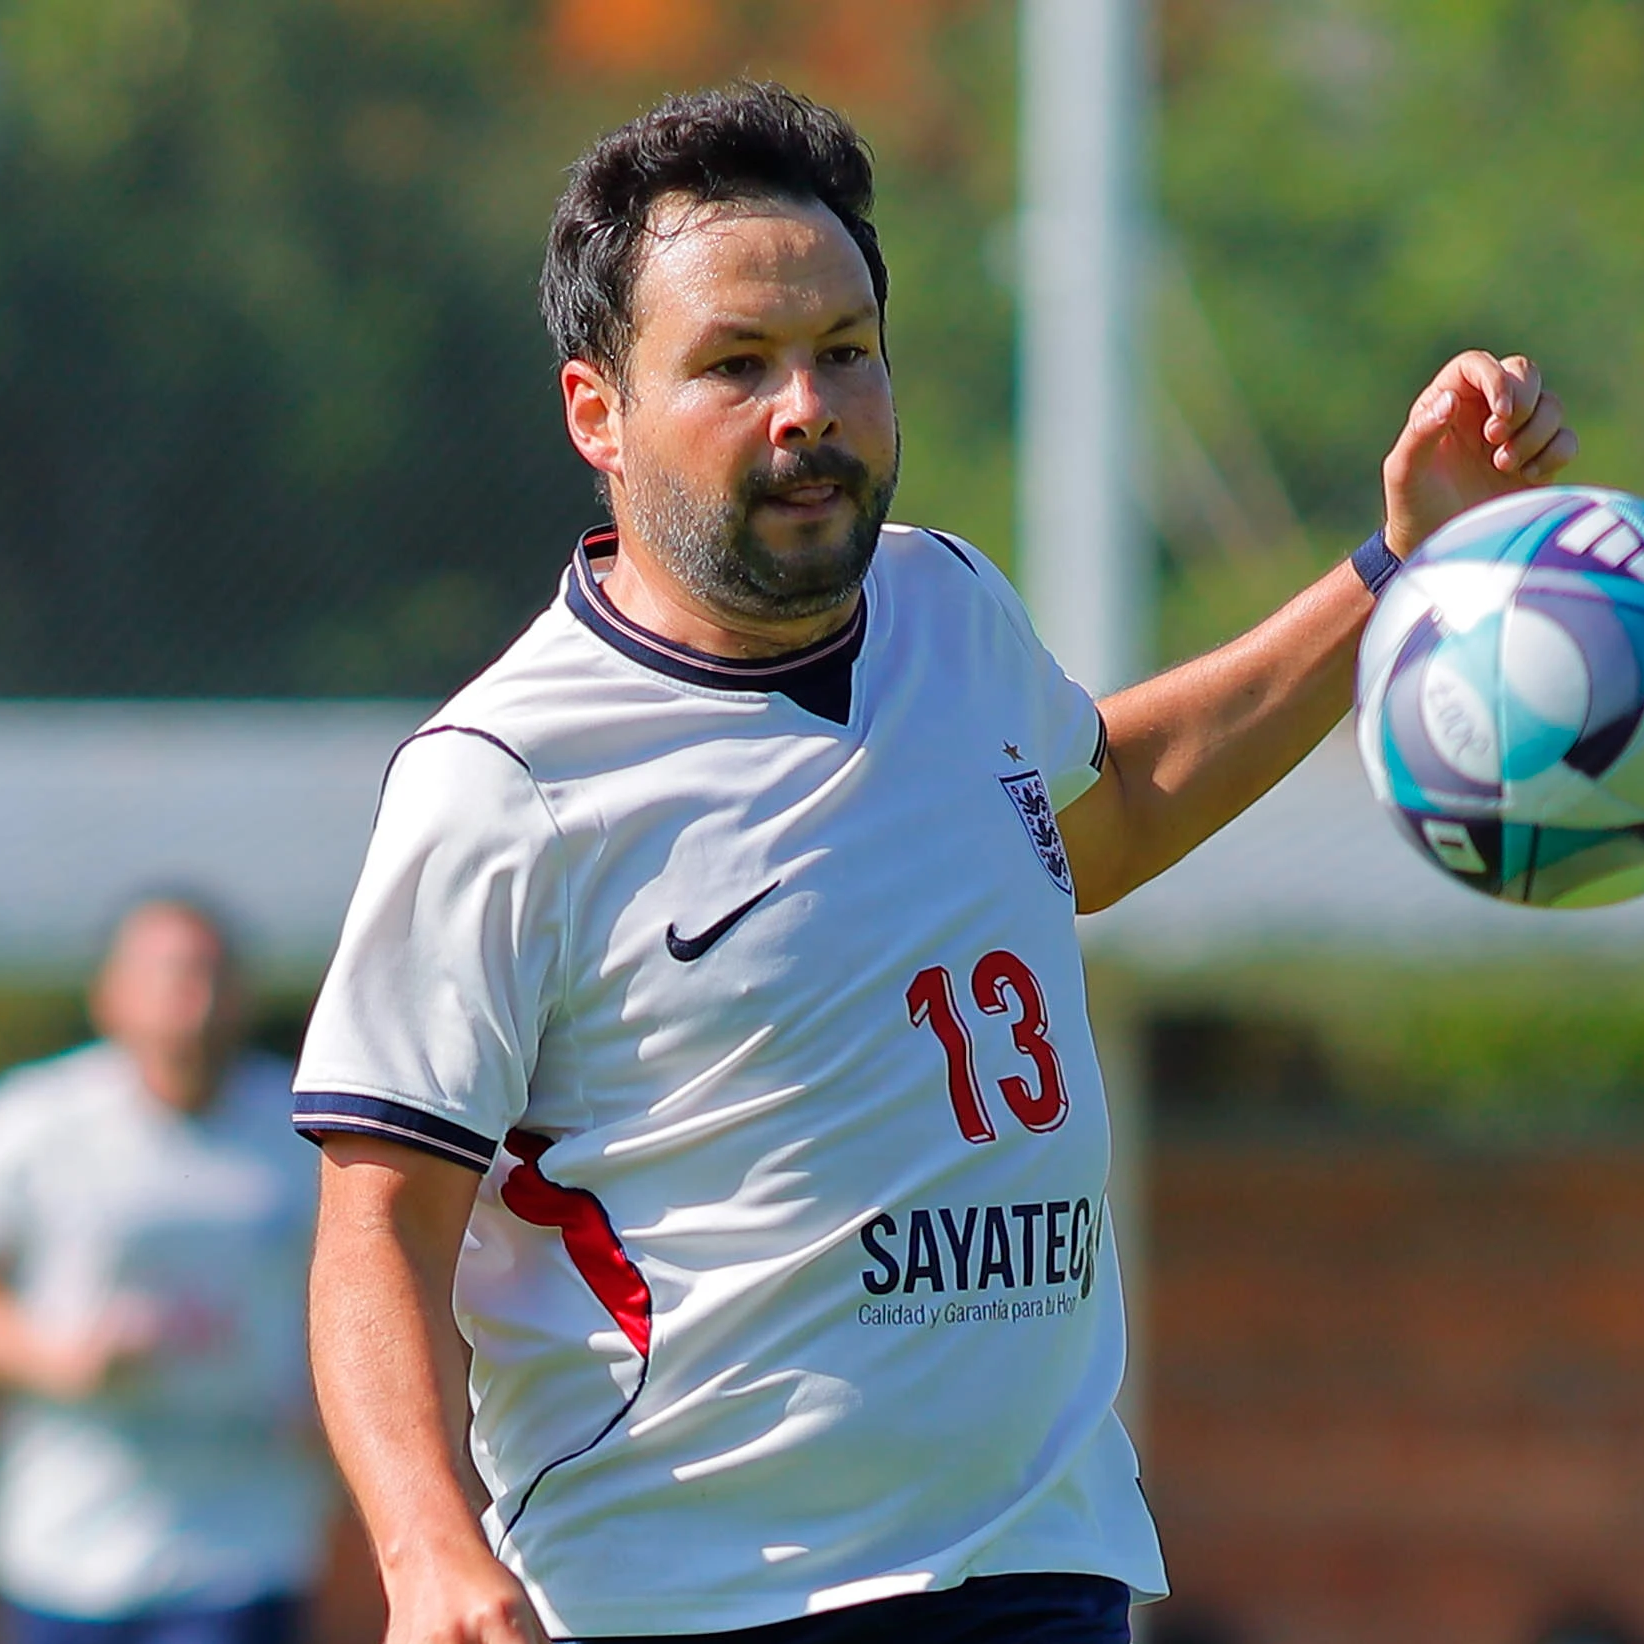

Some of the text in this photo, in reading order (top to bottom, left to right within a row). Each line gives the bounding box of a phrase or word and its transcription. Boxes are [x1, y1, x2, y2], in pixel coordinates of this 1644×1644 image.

[905, 949, 1070, 1144] 13
[858, 1303, 926, 1326] Calidad
[929, 1307, 940, 1329] y
[944, 1298, 1009, 1323] Garantía
[1012, 1299, 1043, 1324] para
